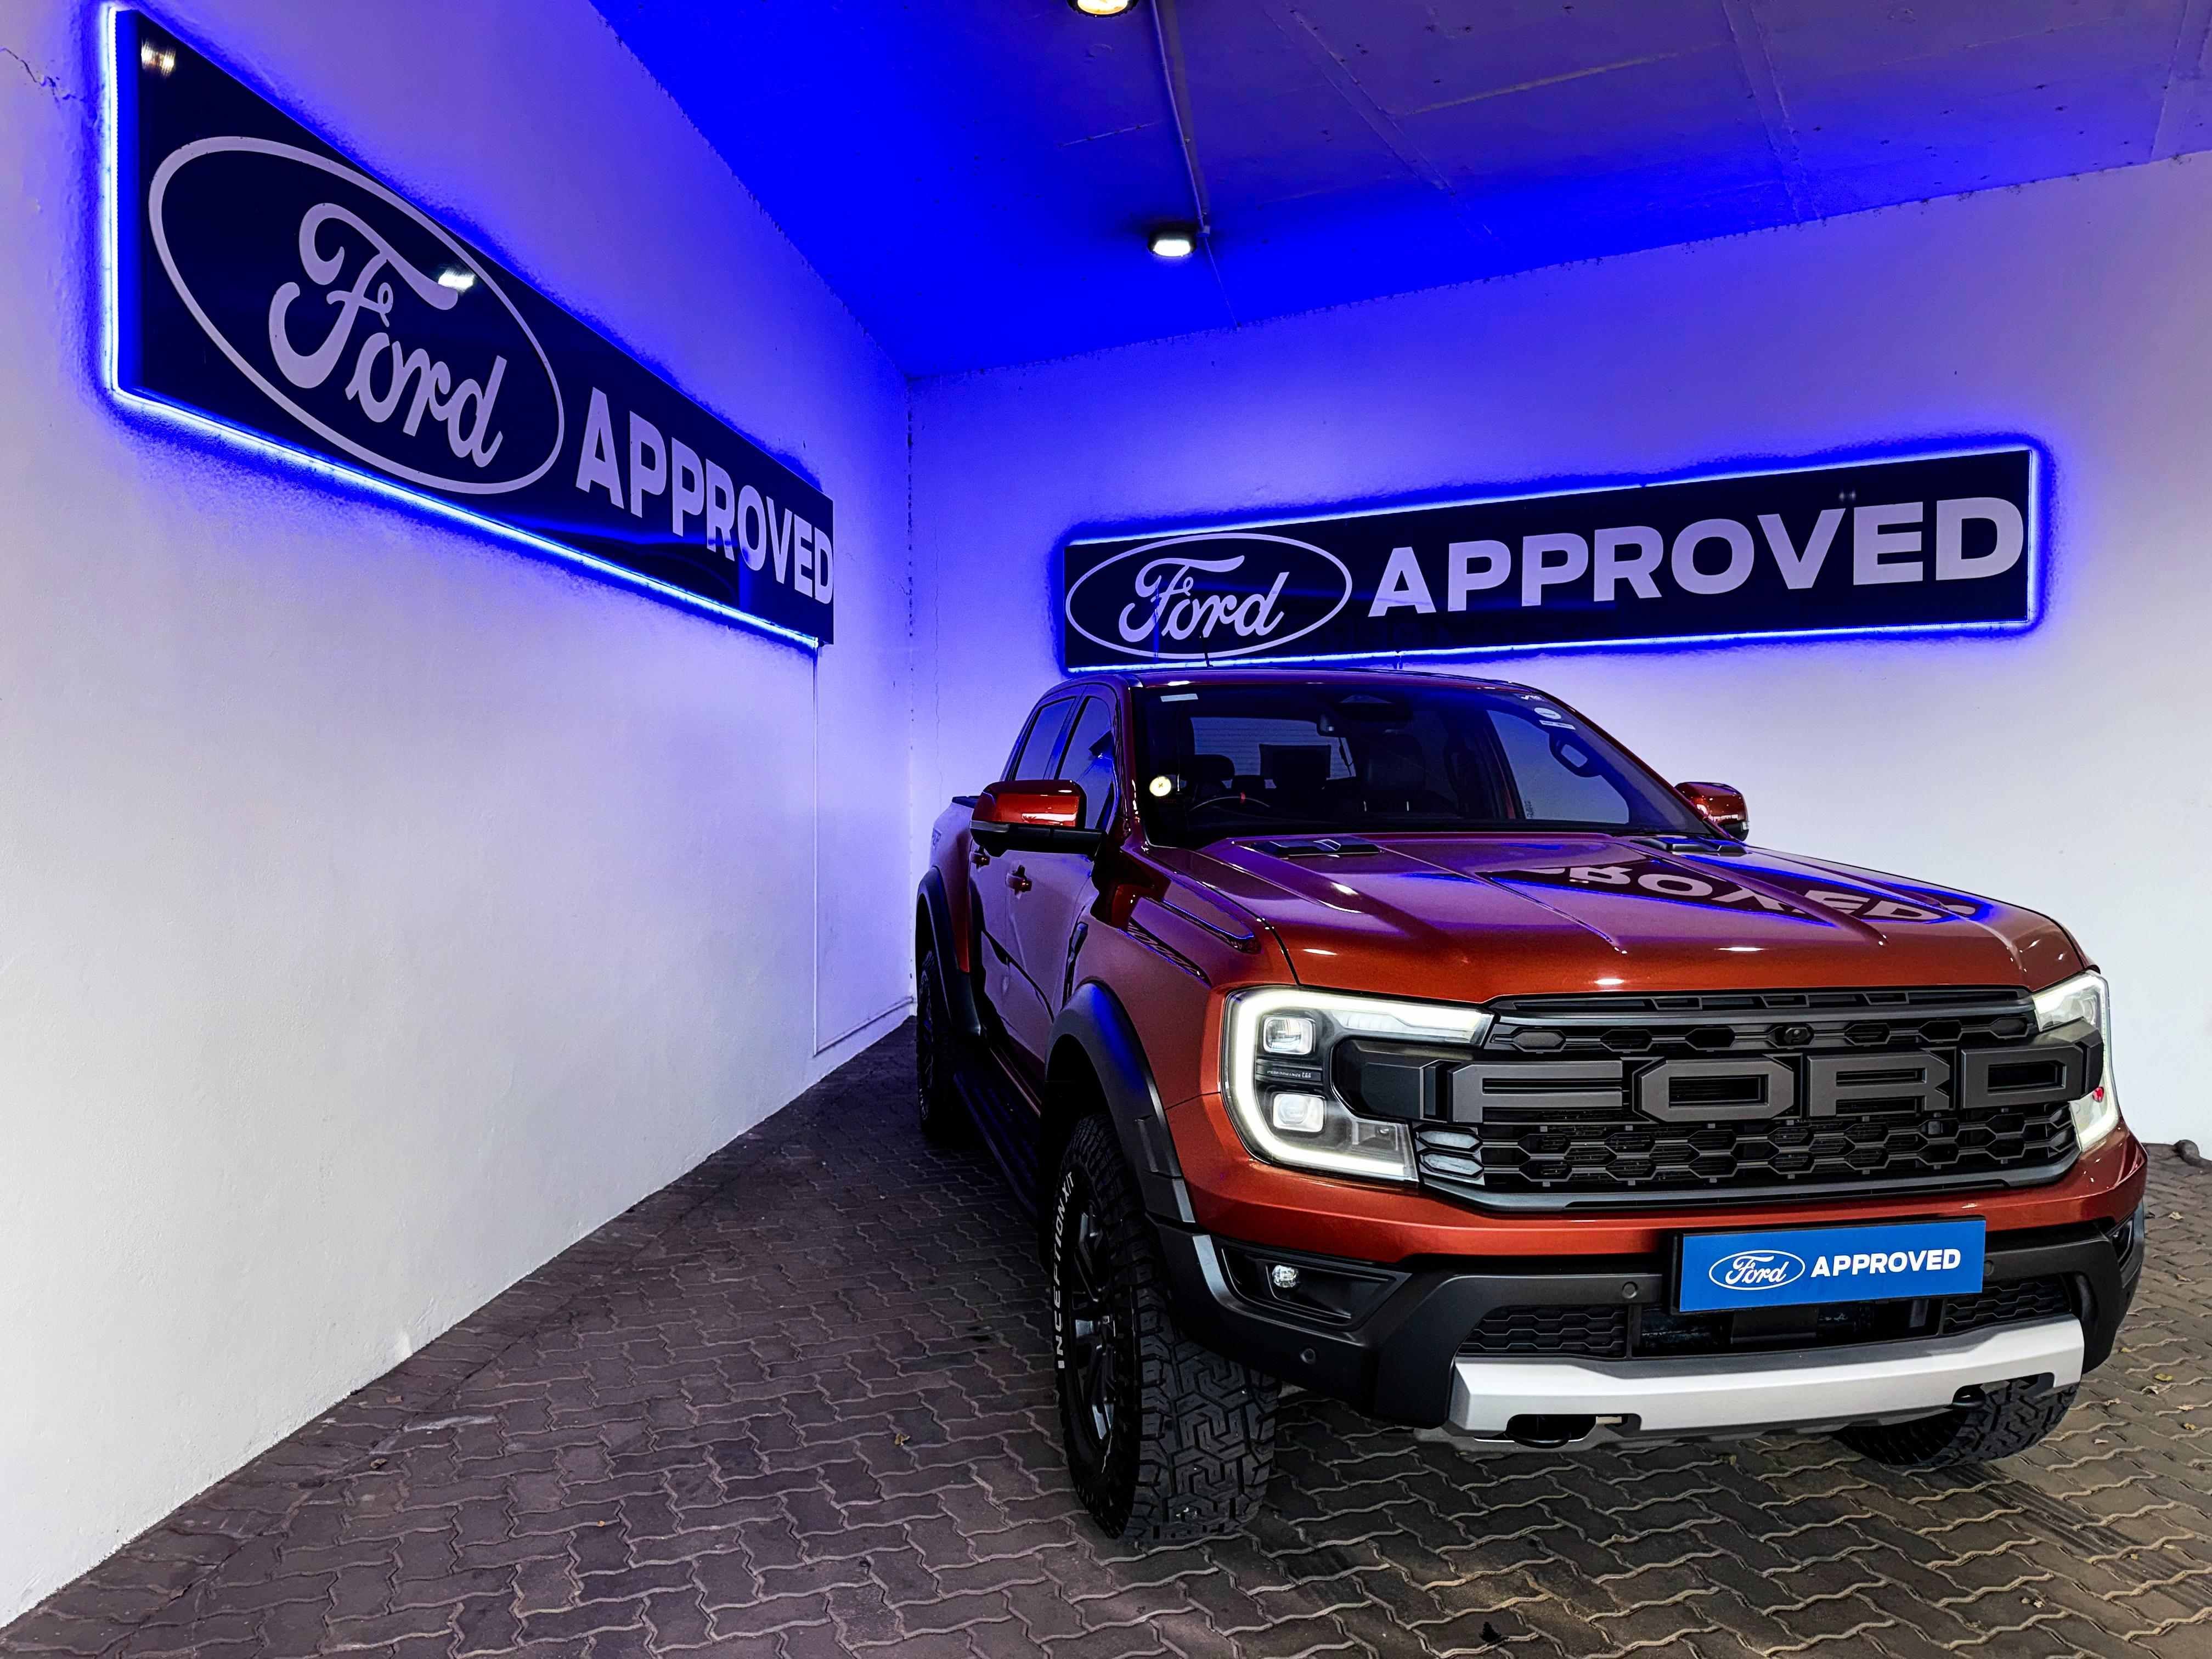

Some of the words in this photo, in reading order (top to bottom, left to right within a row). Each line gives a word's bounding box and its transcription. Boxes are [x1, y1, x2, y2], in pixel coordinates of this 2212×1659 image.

[269, 202, 507, 467] Ford
[576, 387, 833, 604] APPROVED
[1118, 555, 1290, 642] Ford
[1368, 498, 2024, 617] APPROVED
[1453, 1045, 2084, 1122] FORD
[1053, 1197, 1065, 1369] INCEPTION
[1725, 1255, 1787, 1284] Ford
[1810, 1249, 1961, 1278] APPROVED
